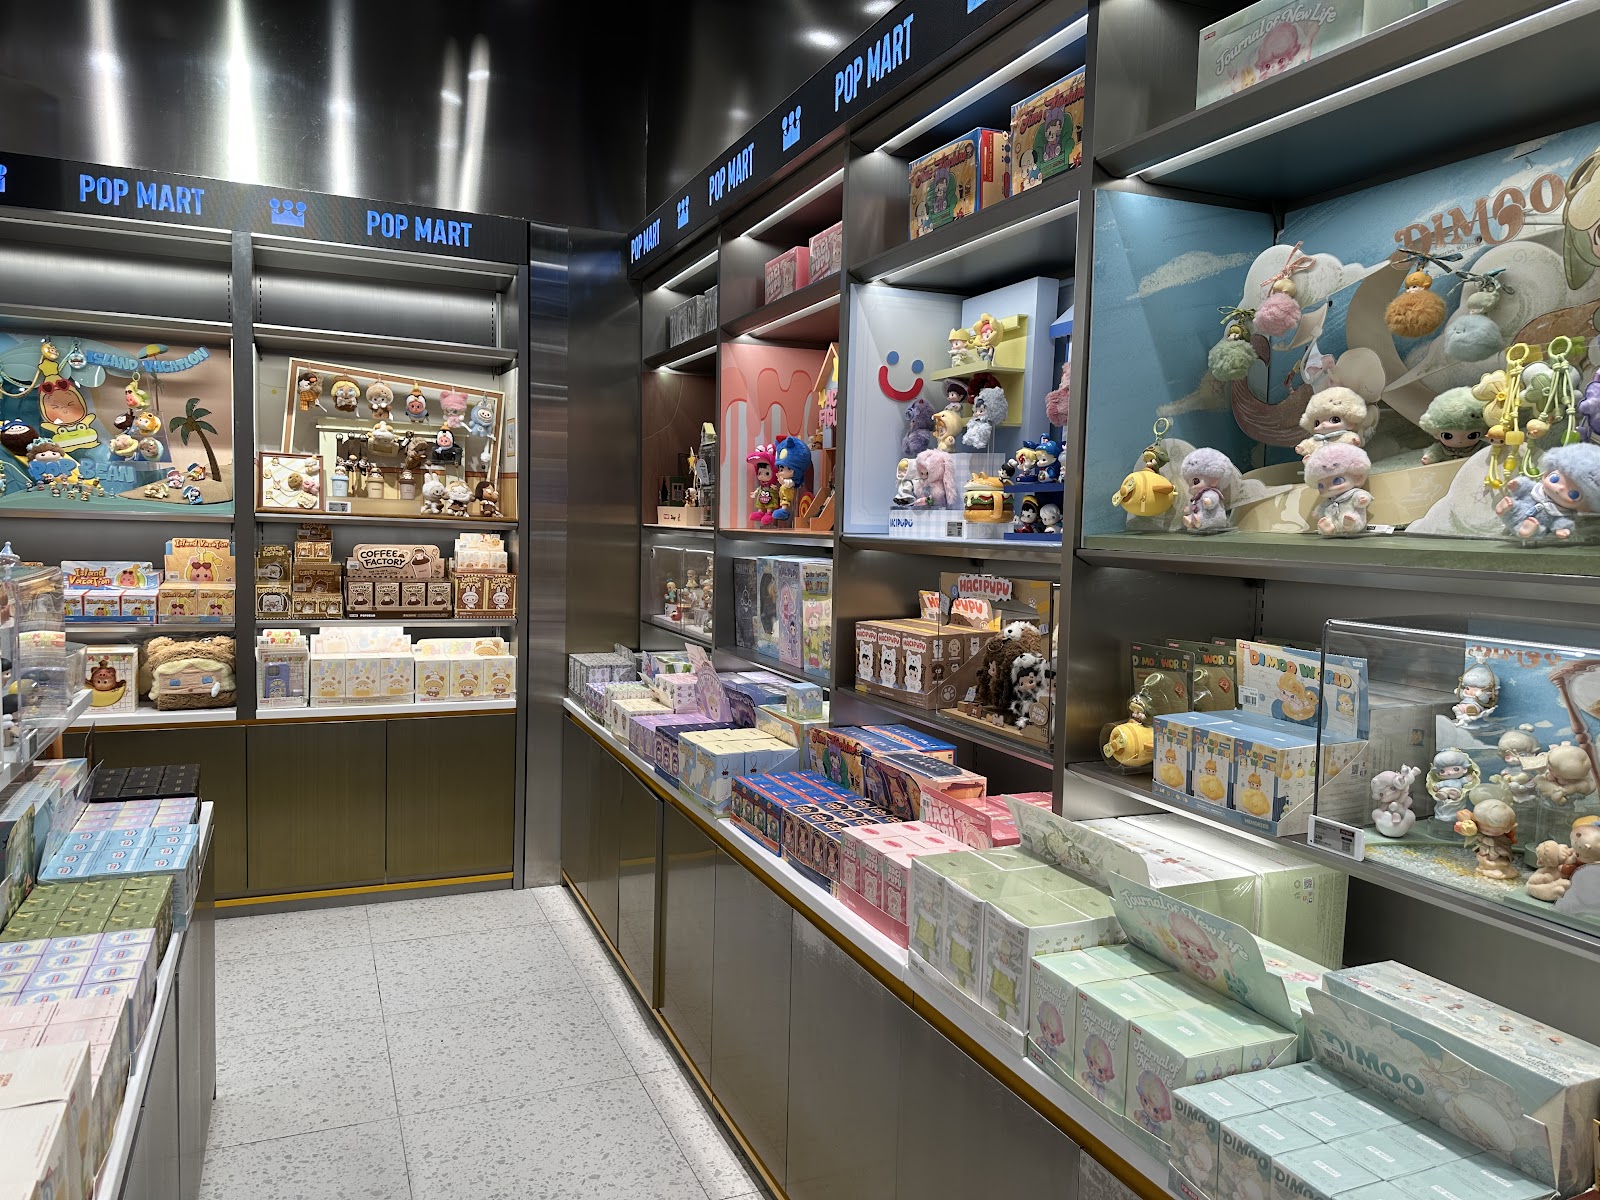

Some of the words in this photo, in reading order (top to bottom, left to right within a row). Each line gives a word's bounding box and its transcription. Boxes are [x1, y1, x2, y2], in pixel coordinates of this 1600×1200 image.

[1215, 26, 1264, 76] Journal
[1264, 15, 1281, 32] of
[1281, 5, 1312, 23] New
[1309, 3, 1337, 25] Life
[834, 56, 863, 112] POP
[866, 13, 914, 88] MART
[708, 170, 725, 206] POP
[727, 143, 755, 192] MART
[79, 173, 128, 204] POP
[136, 181, 205, 215] MART
[367, 210, 408, 239] POP
[415, 219, 473, 248] MART
[1392, 172, 1566, 270] DIMOO
[630, 236, 643, 264] POP
[643, 218, 661, 258] MART
[86, 350, 139, 371] ISLAND
[142, 345, 211, 373] VACATION
[80, 459, 136, 483] BEAN
[175, 538, 197, 547] Island
[200, 540, 229, 549] Vacation
[360, 549, 398, 559] COFFEE
[74, 567, 106, 578] Island
[364, 559, 405, 567] FACTORY
[68, 575, 111, 587] Vacation
[959, 578, 1011, 597] HACIPUPU
[856, 630, 877, 642] HACIPUPU
[878, 634, 900, 646] HACIPUPU
[903, 639, 926, 652] HACIPUPU
[1161, 658, 1188, 670] WORD
[1203, 655, 1234, 666] WORD
[1249, 649, 1297, 674] DIMOO
[1299, 664, 1352, 689] WORLD
[924, 804, 956, 826] HACI
[1120, 891, 1167, 912] Journal
[1166, 900, 1181, 914] of
[1182, 903, 1218, 936] New
[1217, 930, 1250, 962] Life
[1034, 973, 1062, 997] Journal
[1061, 991, 1070, 1003] of
[1081, 1003, 1111, 1034] Journal
[1111, 1026, 1121, 1041] of
[1134, 1037, 1169, 1070] Journal
[1169, 1062, 1181, 1077] of
[1320, 1028, 1425, 1096] DIMOO
[1173, 1098, 1216, 1133] DIMOO
[1222, 1130, 1269, 1169] DIMOO
